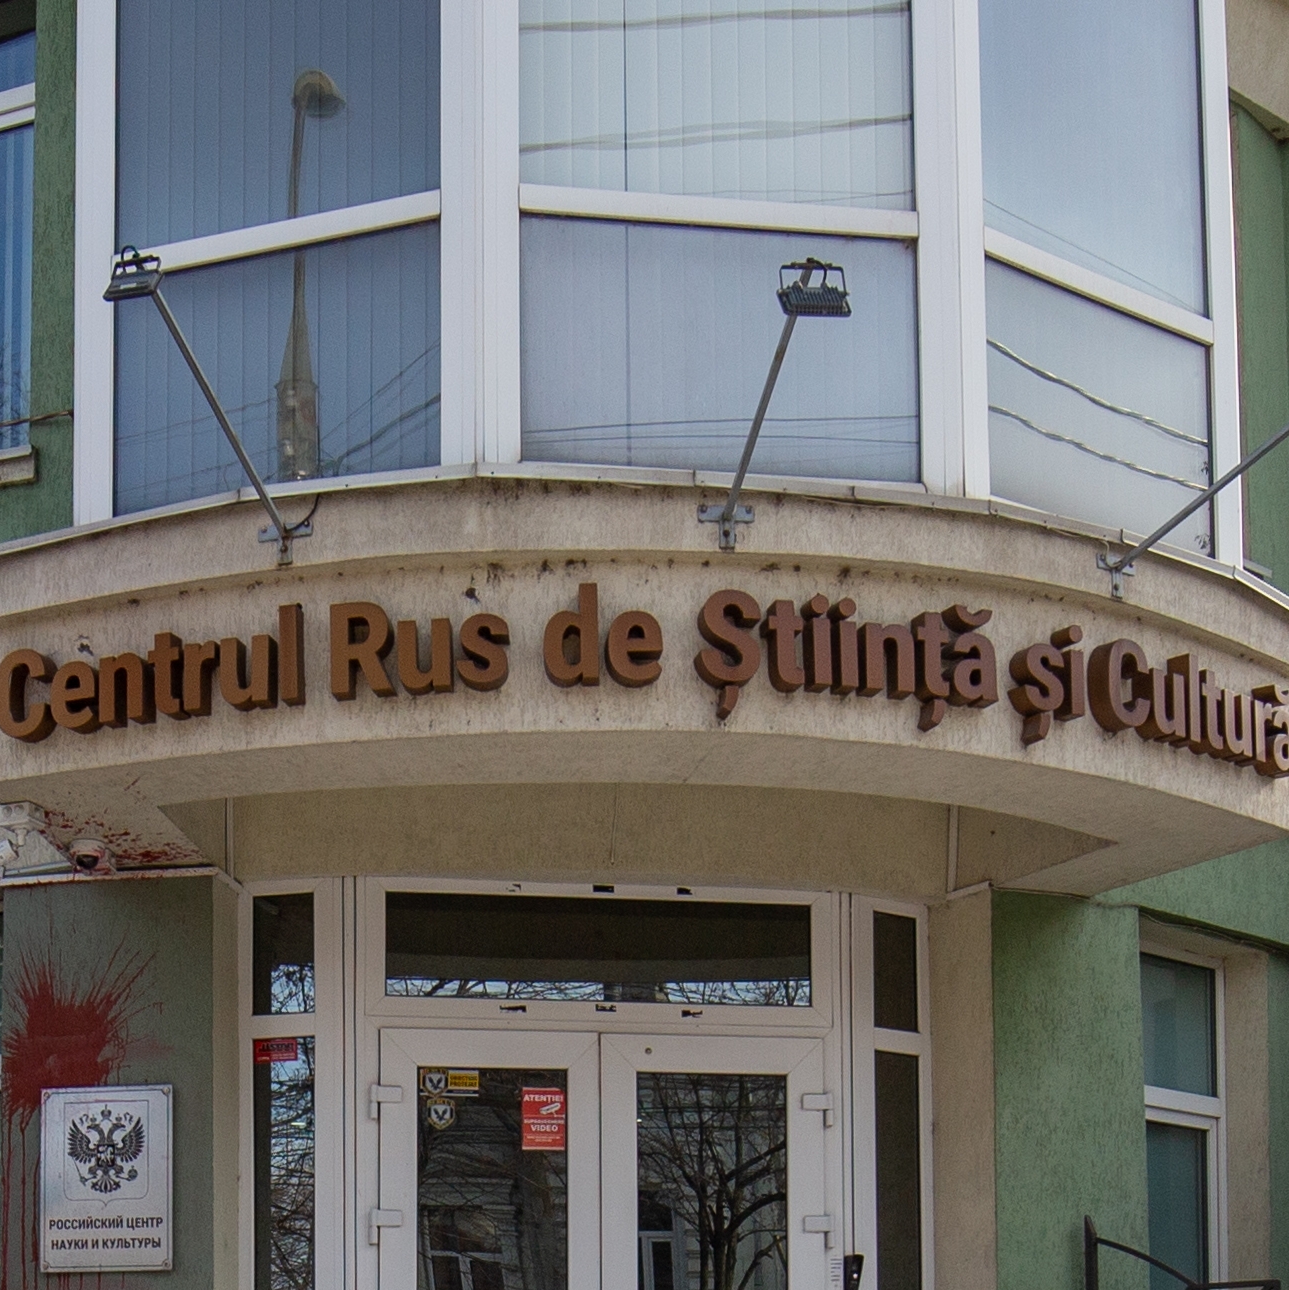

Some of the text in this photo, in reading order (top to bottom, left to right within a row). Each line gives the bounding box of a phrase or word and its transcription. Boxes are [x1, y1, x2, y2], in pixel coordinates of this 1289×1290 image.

[330, 599, 510, 700] Rus
[543, 582, 662, 689] de
[696, 588, 999, 732] Știință
[1009, 625, 1085, 745] și
[530, 1124, 559, 1132] VIDEO
[49, 1216, 163, 1231] РОССИЙСКИЙ ЦЕНТР
[51, 1237, 161, 1250] НАУКИ И КУЛЬТУРЫ
